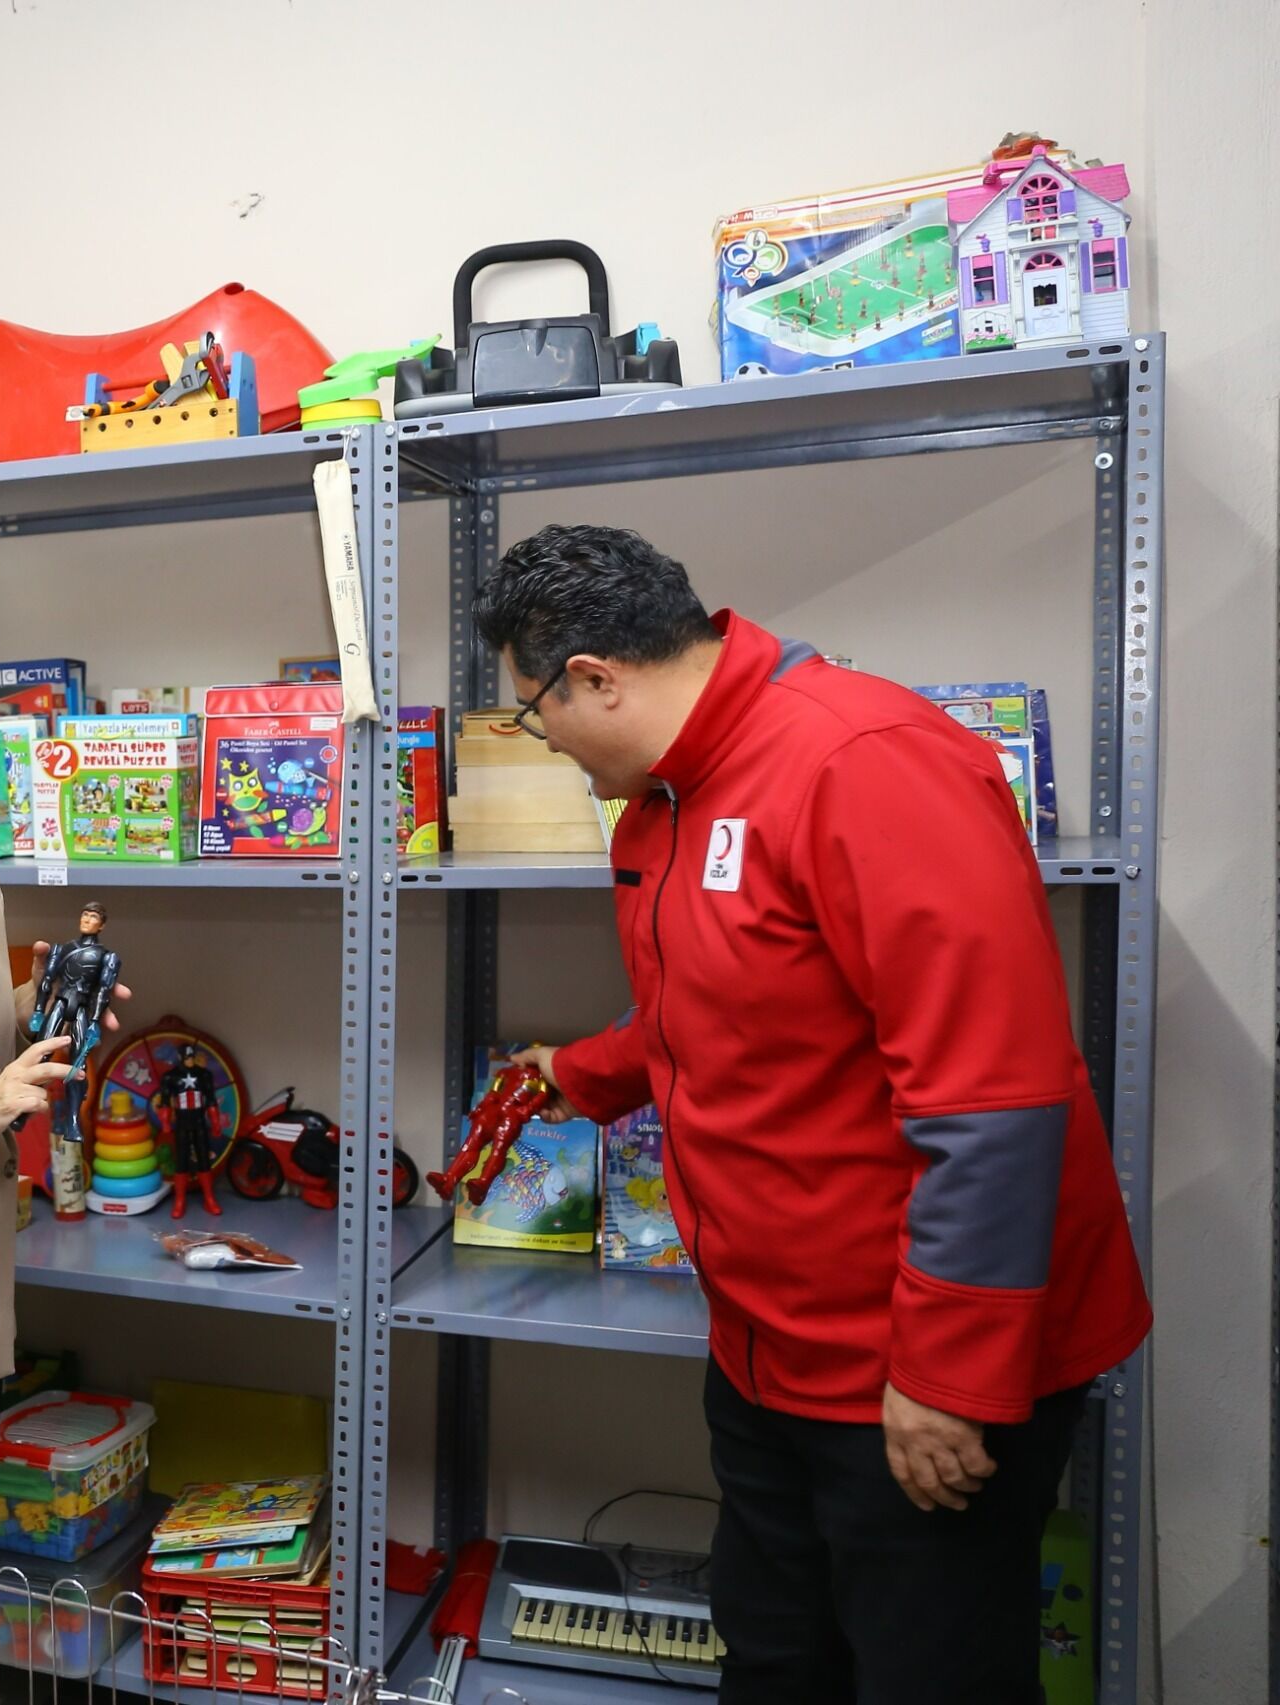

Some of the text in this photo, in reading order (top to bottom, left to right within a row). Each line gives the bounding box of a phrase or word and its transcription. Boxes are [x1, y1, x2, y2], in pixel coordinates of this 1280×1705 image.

[344, 542, 355, 570] YAMAHA
[19, 667, 61, 681] ACTIVE
[53, 745, 72, 776] 2
[123, 755, 167, 766] PUZZLE
